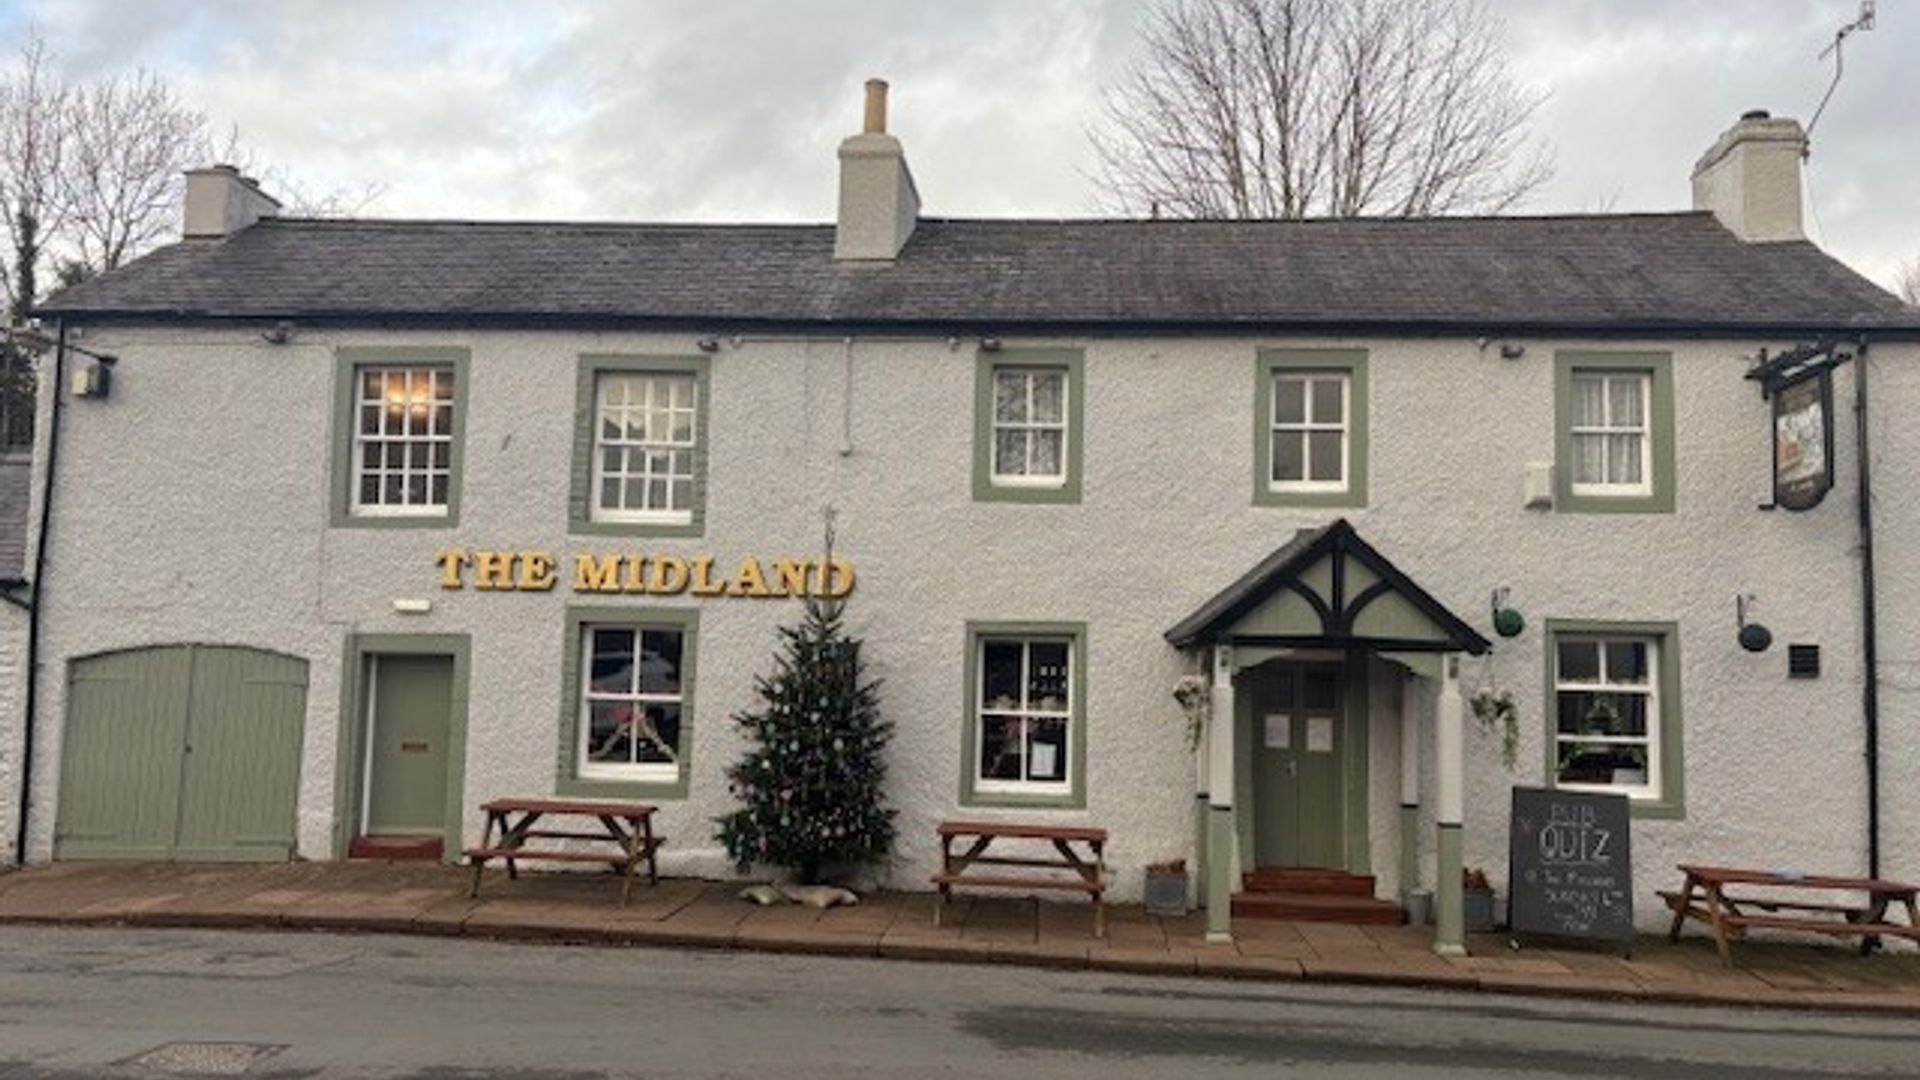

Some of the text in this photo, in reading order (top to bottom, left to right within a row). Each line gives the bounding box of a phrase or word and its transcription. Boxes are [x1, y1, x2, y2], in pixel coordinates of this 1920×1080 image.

[437, 550, 858, 598] THE MIDLAND
[1539, 825, 1611, 861] QUIZ
